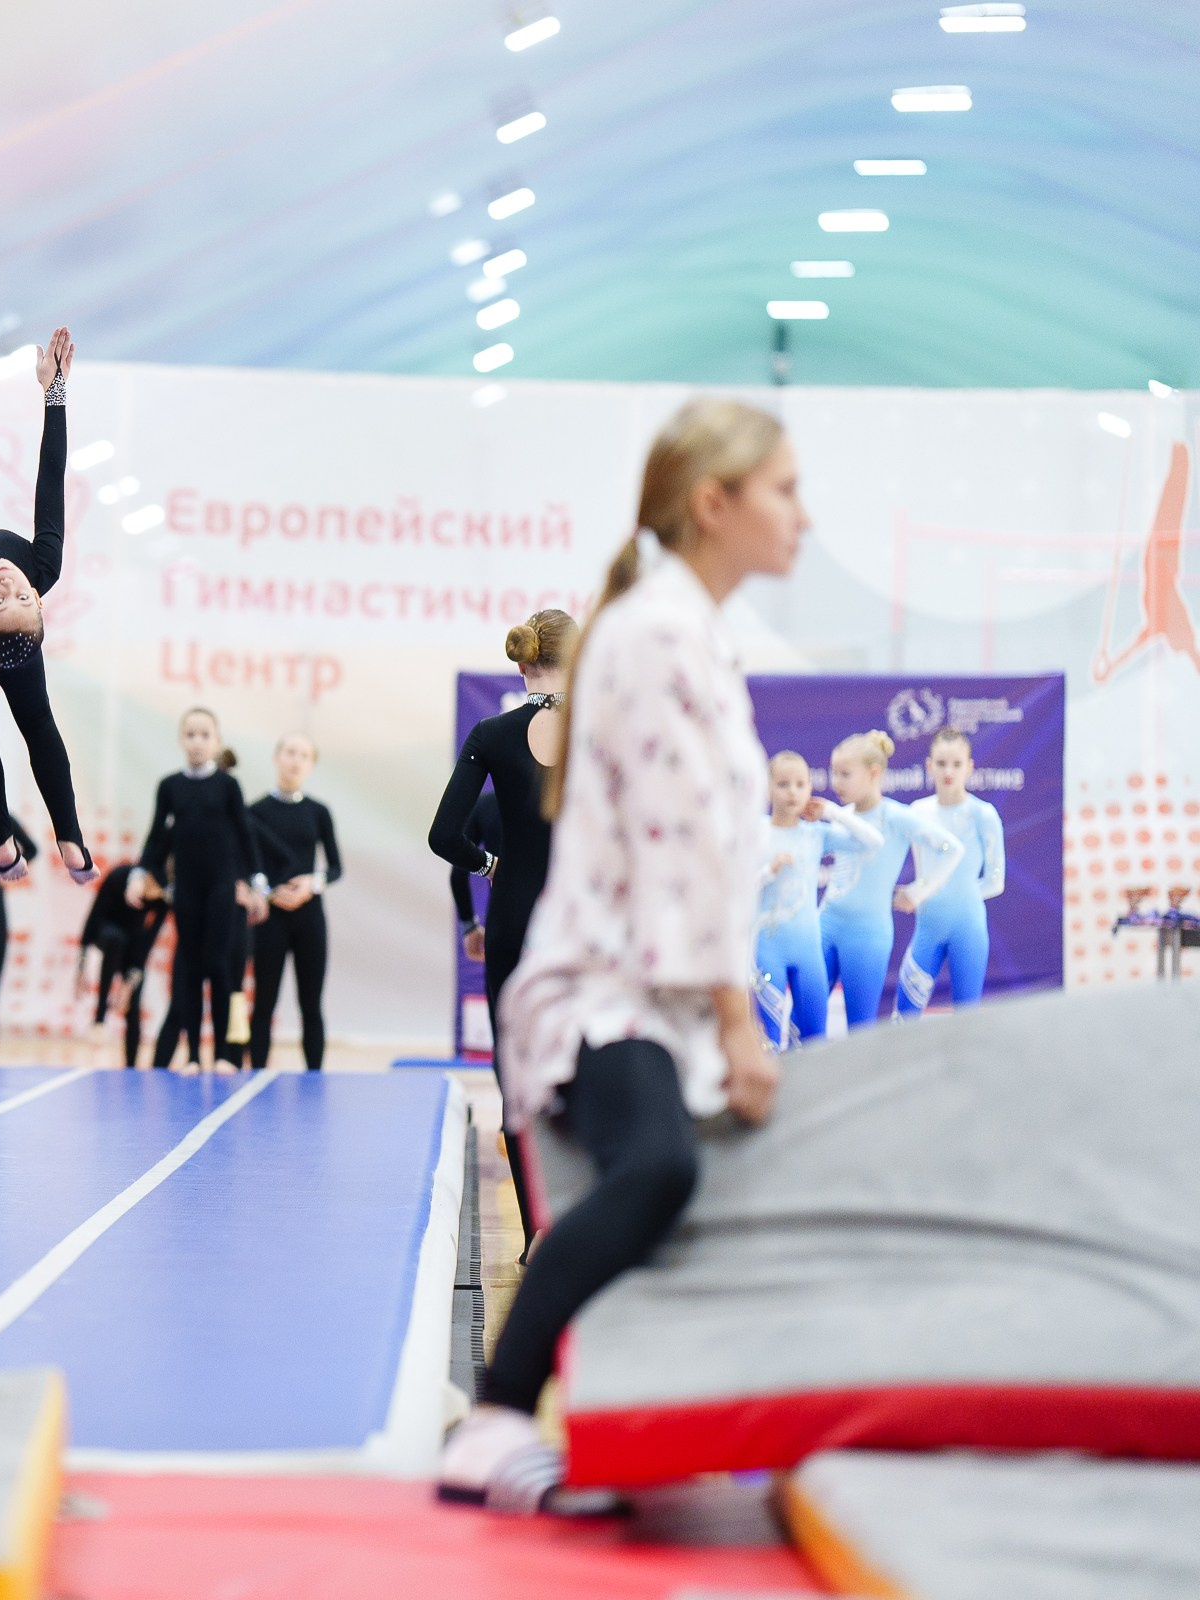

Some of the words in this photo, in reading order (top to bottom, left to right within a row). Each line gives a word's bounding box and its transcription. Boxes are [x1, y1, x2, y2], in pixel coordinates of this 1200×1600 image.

[165, 488, 574, 552] Европейский
[162, 564, 597, 624] Гимнастическ
[161, 639, 342, 700] Центр
